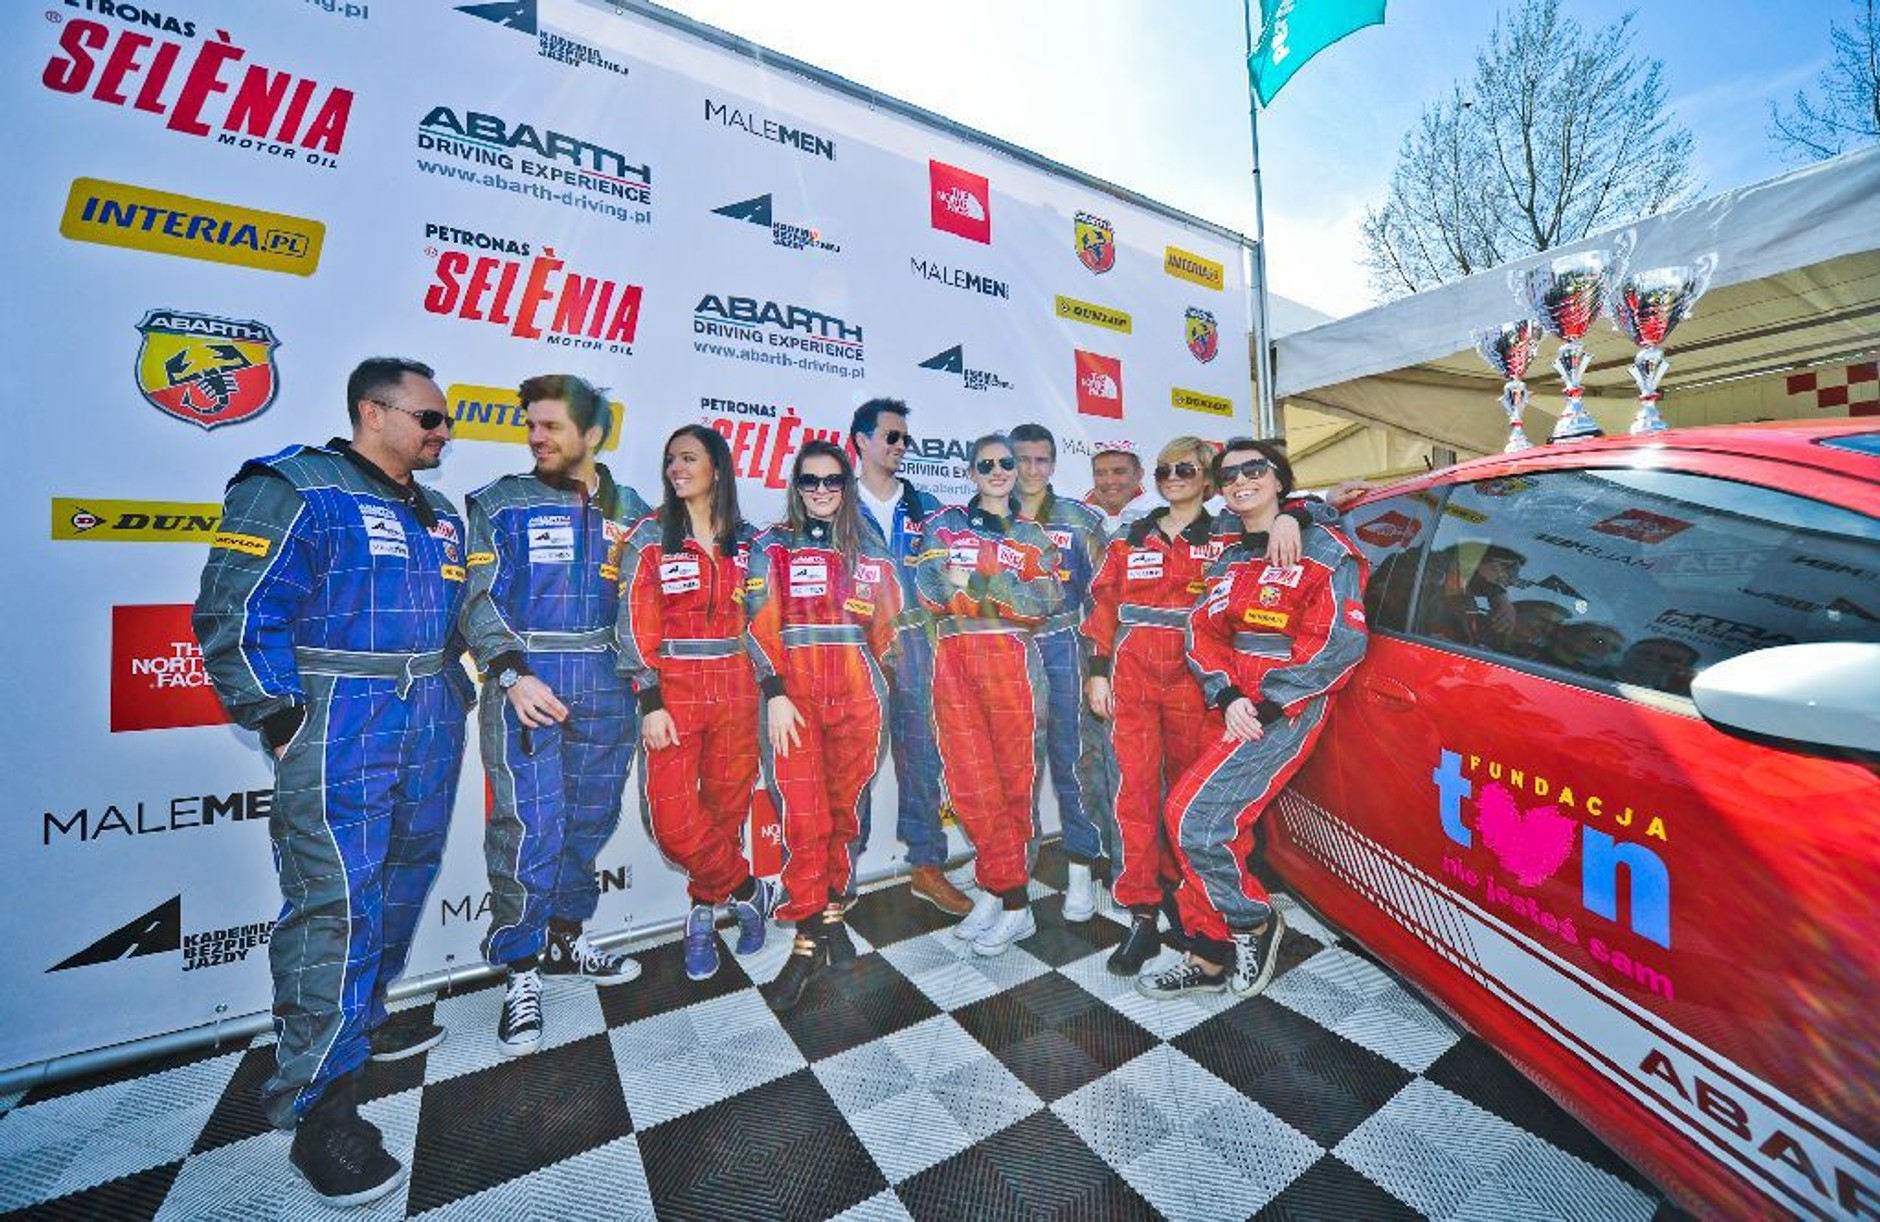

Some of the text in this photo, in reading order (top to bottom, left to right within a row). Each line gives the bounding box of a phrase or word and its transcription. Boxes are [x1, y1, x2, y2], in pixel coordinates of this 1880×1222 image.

[64, 0, 196, 38] TRONAS
[42, 18, 354, 155] SELÈNIA
[217, 133, 339, 169] MOTOR OIL
[419, 106, 651, 185] ABARTH
[418, 133, 651, 205] DRIVING EXPERIENCE
[416, 158, 651, 224] www.abarth-driving.pl
[425, 223, 531, 257] PETRONAS
[423, 245, 644, 344] SELÈNIA
[150, 315, 265, 340] ABARTH
[693, 293, 864, 343] ABARTH
[546, 335, 634, 356] MOTOR OIL
[693, 319, 865, 362] DRIVING EXPERIENCE
[693, 339, 866, 379] www.abarth-driving.pl
[454, 399, 527, 427] INTE
[700, 397, 777, 418] PETRONAS
[898, 462, 950, 479] DRIVING
[111, 513, 221, 532] DUN
[132, 656, 206, 675] NORT
[170, 642, 204, 656] TH
[157, 672, 214, 688] FACE
[1470, 754, 1668, 842] FUNDACJA
[43, 788, 276, 845] MALEME
[181, 948, 249, 972] JAZDY
[183, 932, 271, 960] BEZPIEC
[1588, 936, 1675, 1002] sam
